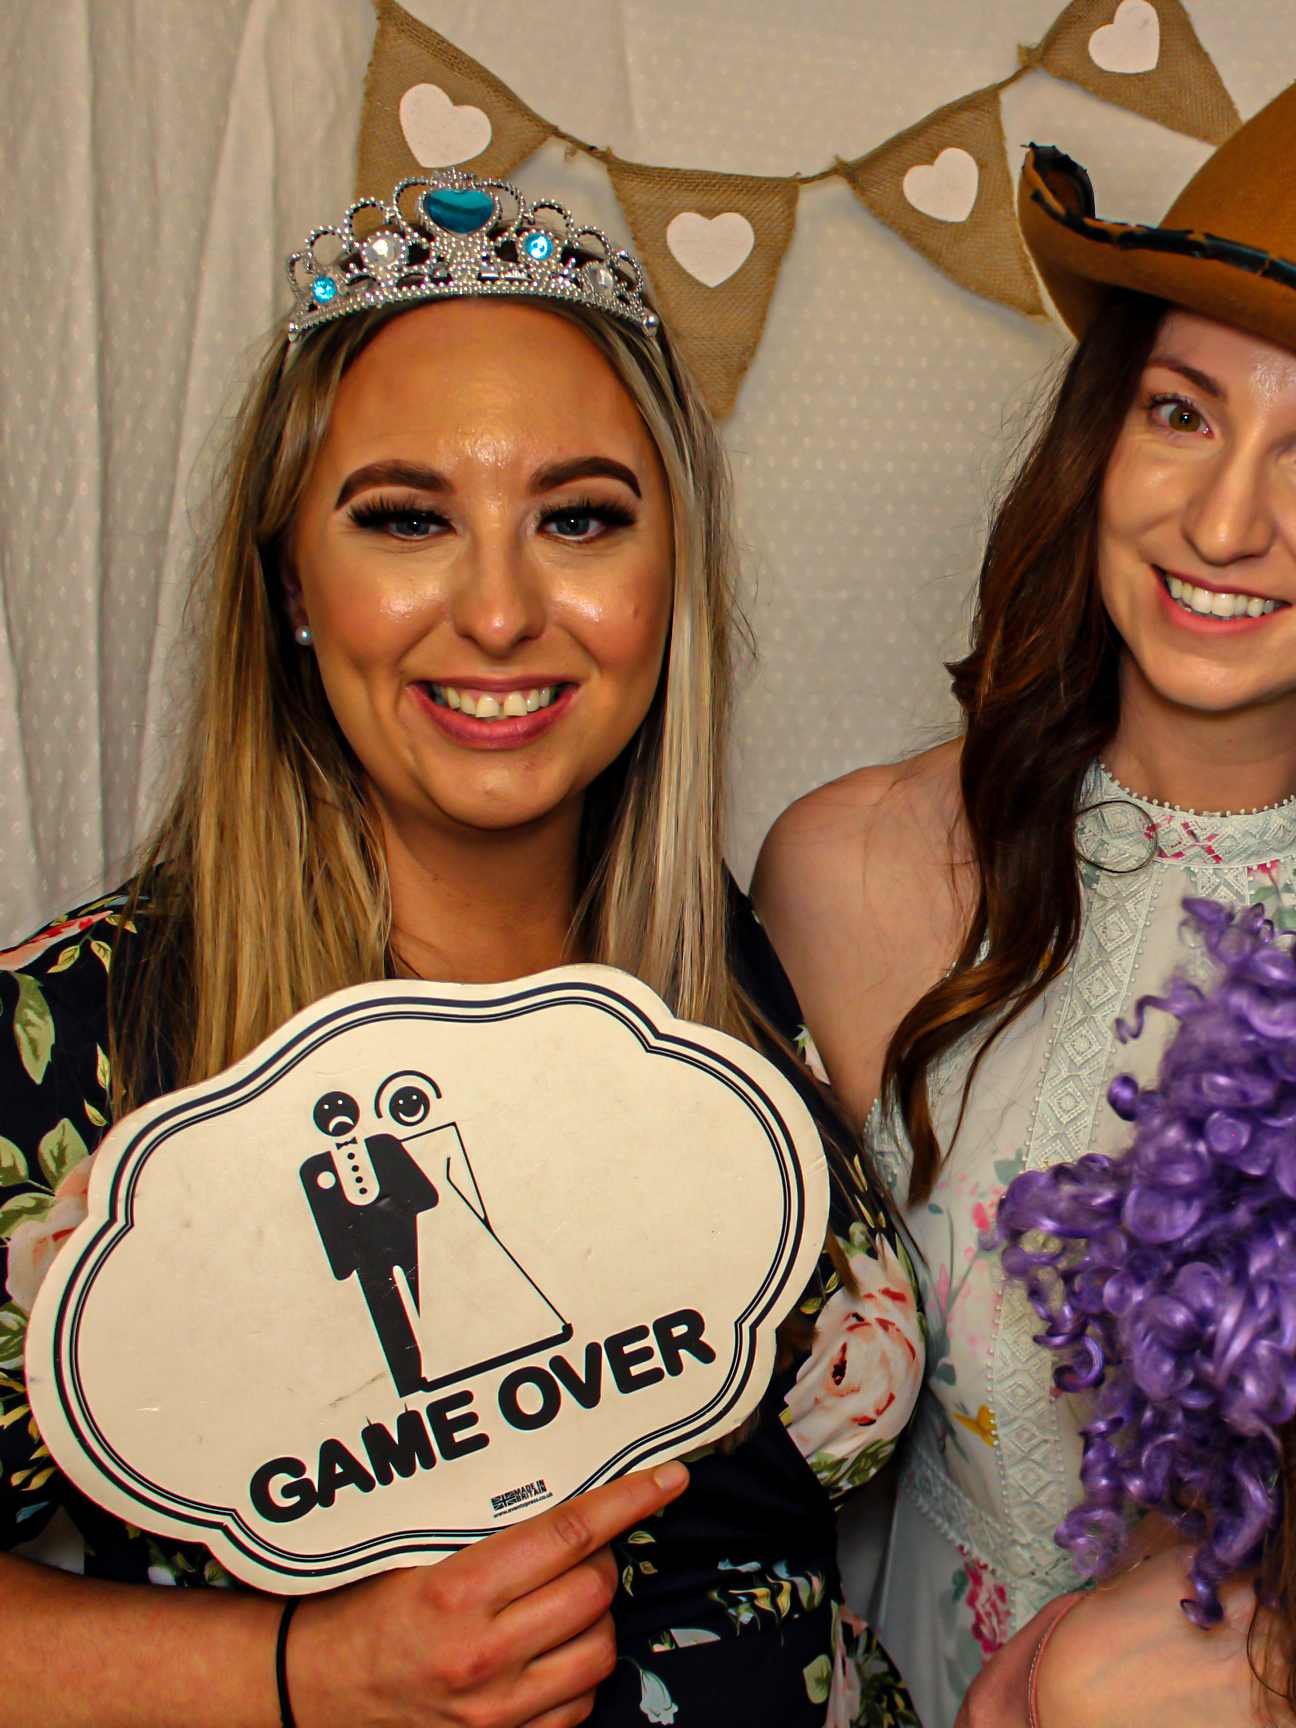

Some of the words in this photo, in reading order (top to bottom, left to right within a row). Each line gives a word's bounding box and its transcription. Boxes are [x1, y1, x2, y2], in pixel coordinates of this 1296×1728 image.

[249, 1390, 490, 1523] GAME
[497, 1308, 717, 1431] OVER
[514, 1482, 535, 1496] MADE
[536, 1479, 546, 1488] IN
[516, 1487, 547, 1502] BRITAIN
